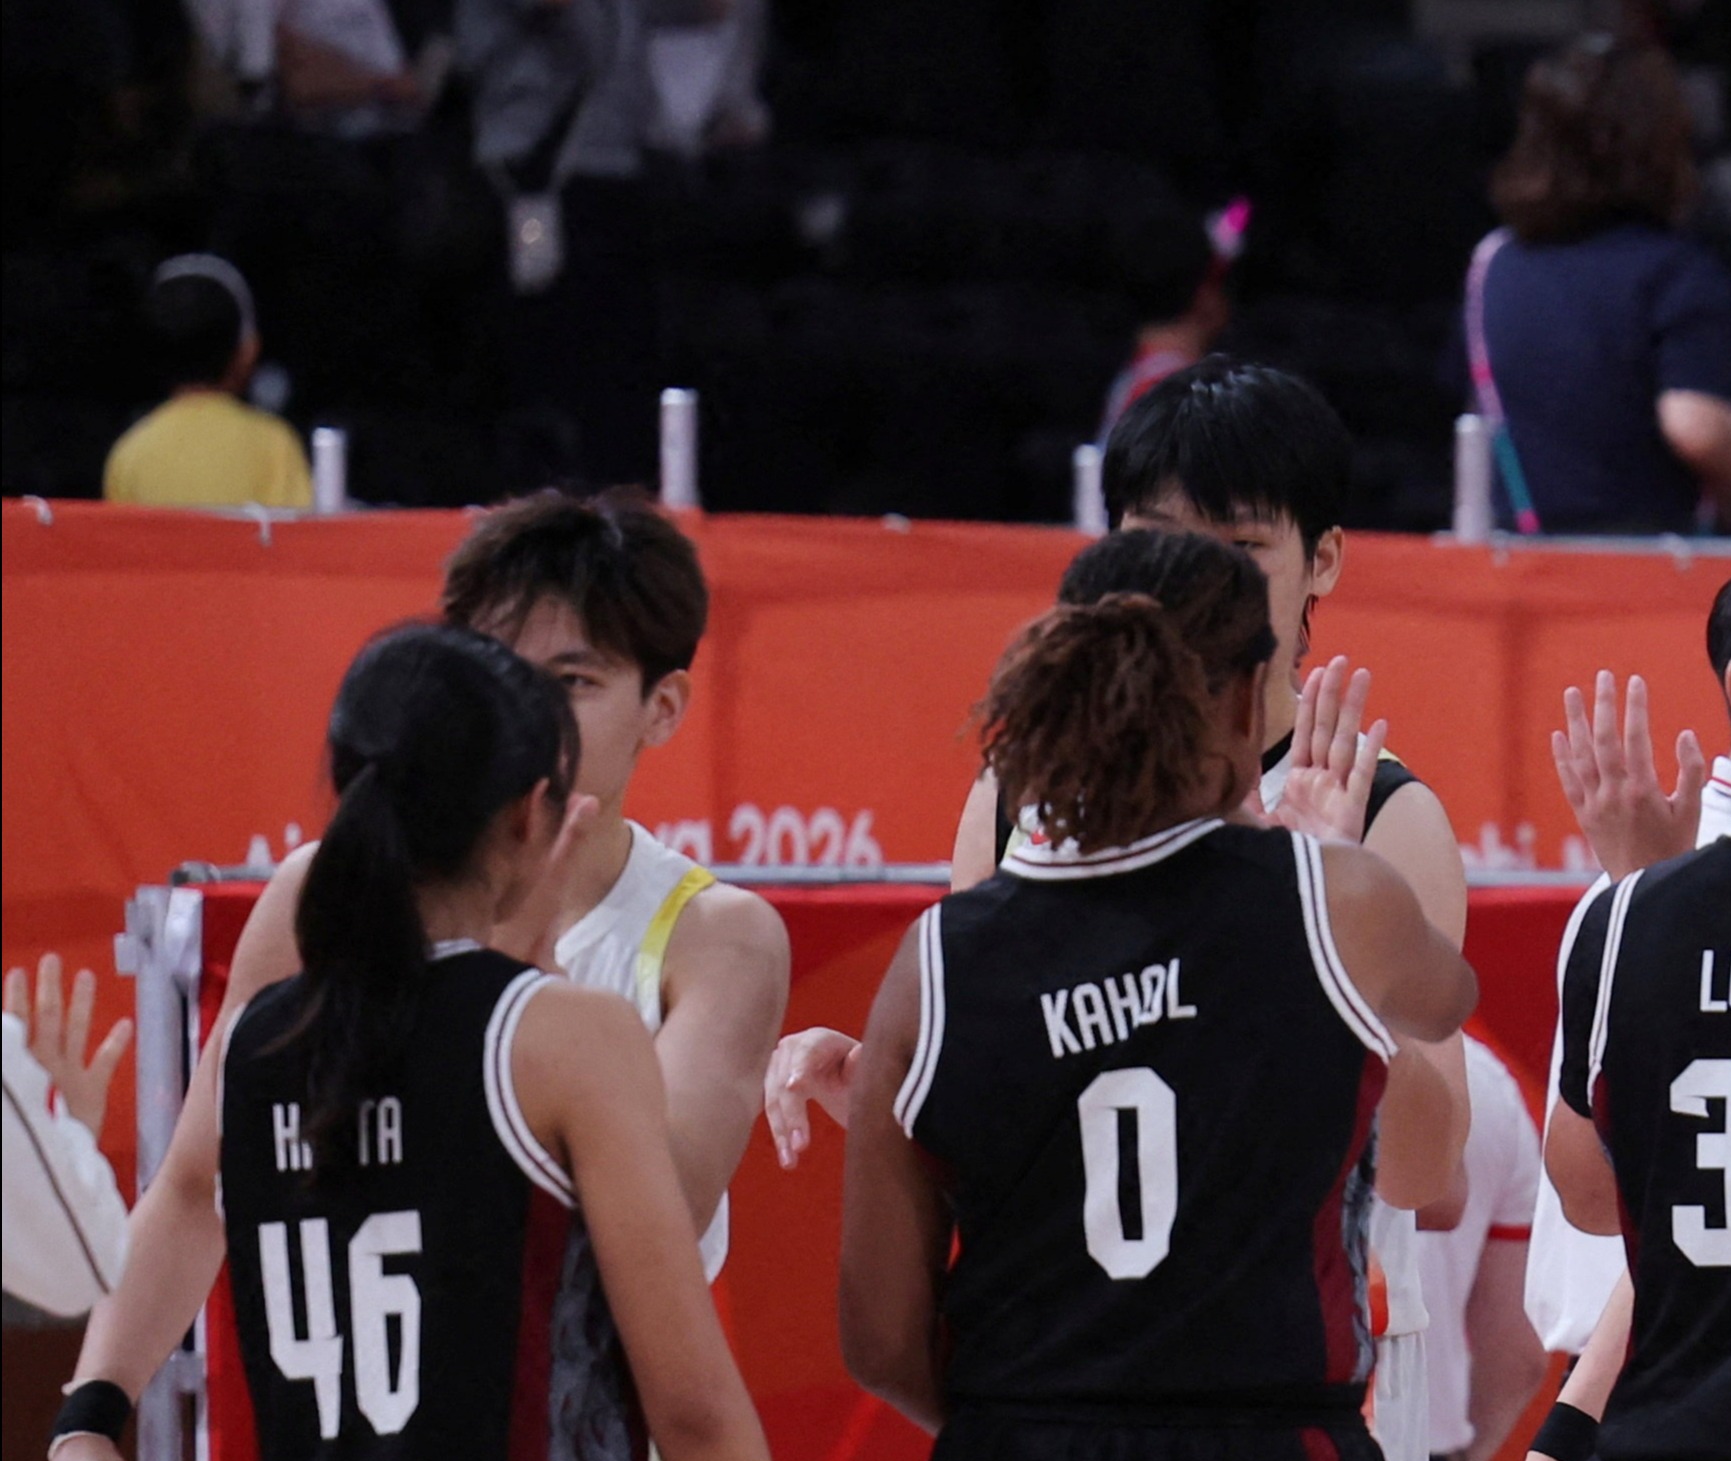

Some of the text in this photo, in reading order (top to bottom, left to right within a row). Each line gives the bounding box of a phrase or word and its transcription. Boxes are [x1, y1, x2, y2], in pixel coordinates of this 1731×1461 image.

[729, 802, 884, 867] 2026
[1077, 1066, 1179, 1280] 0
[258, 1209, 424, 1440] 46
